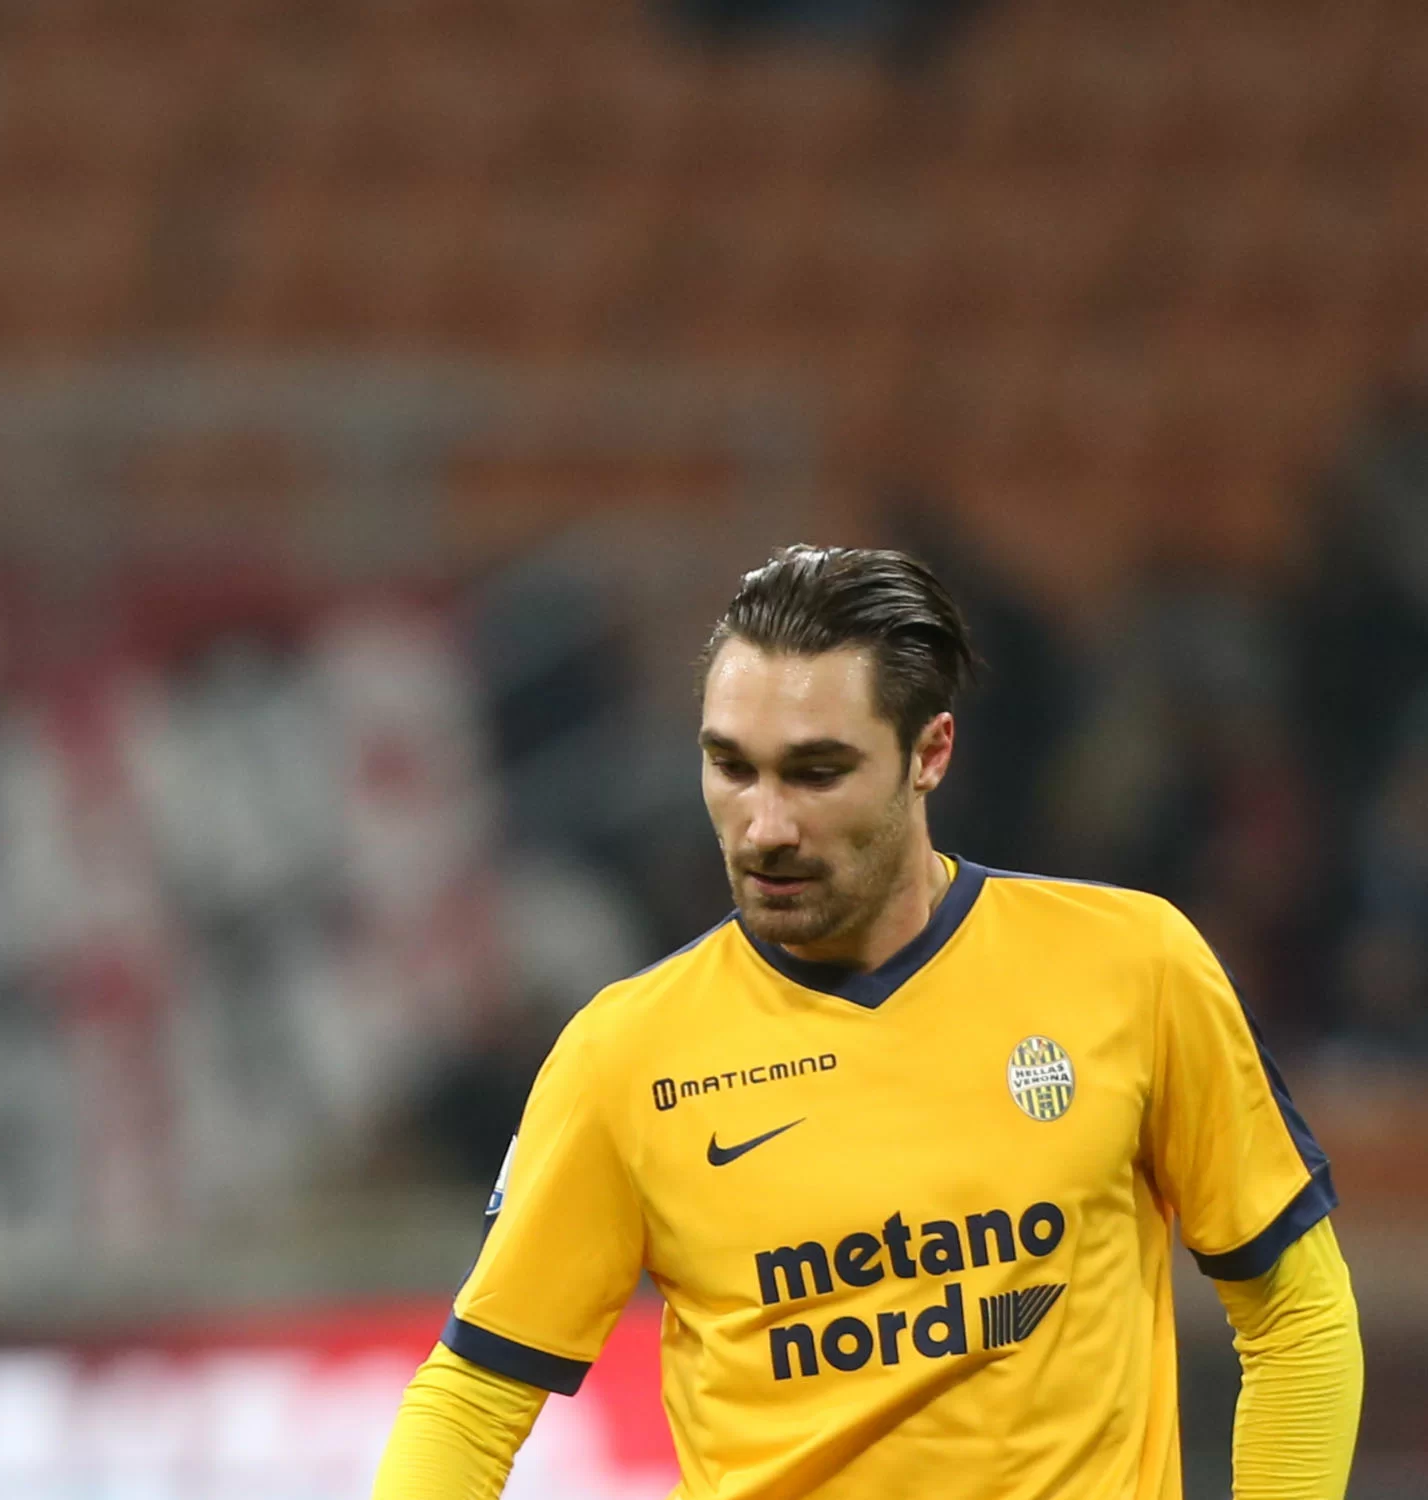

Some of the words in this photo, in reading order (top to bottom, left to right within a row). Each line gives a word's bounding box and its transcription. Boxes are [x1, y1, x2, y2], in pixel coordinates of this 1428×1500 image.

[680, 1053, 837, 1098] MATICMIND
[1014, 1073, 1070, 1088] VERONA
[1015, 1062, 1064, 1079] HELLAS
[755, 1201, 1065, 1305] metano
[769, 1282, 968, 1380] nord
